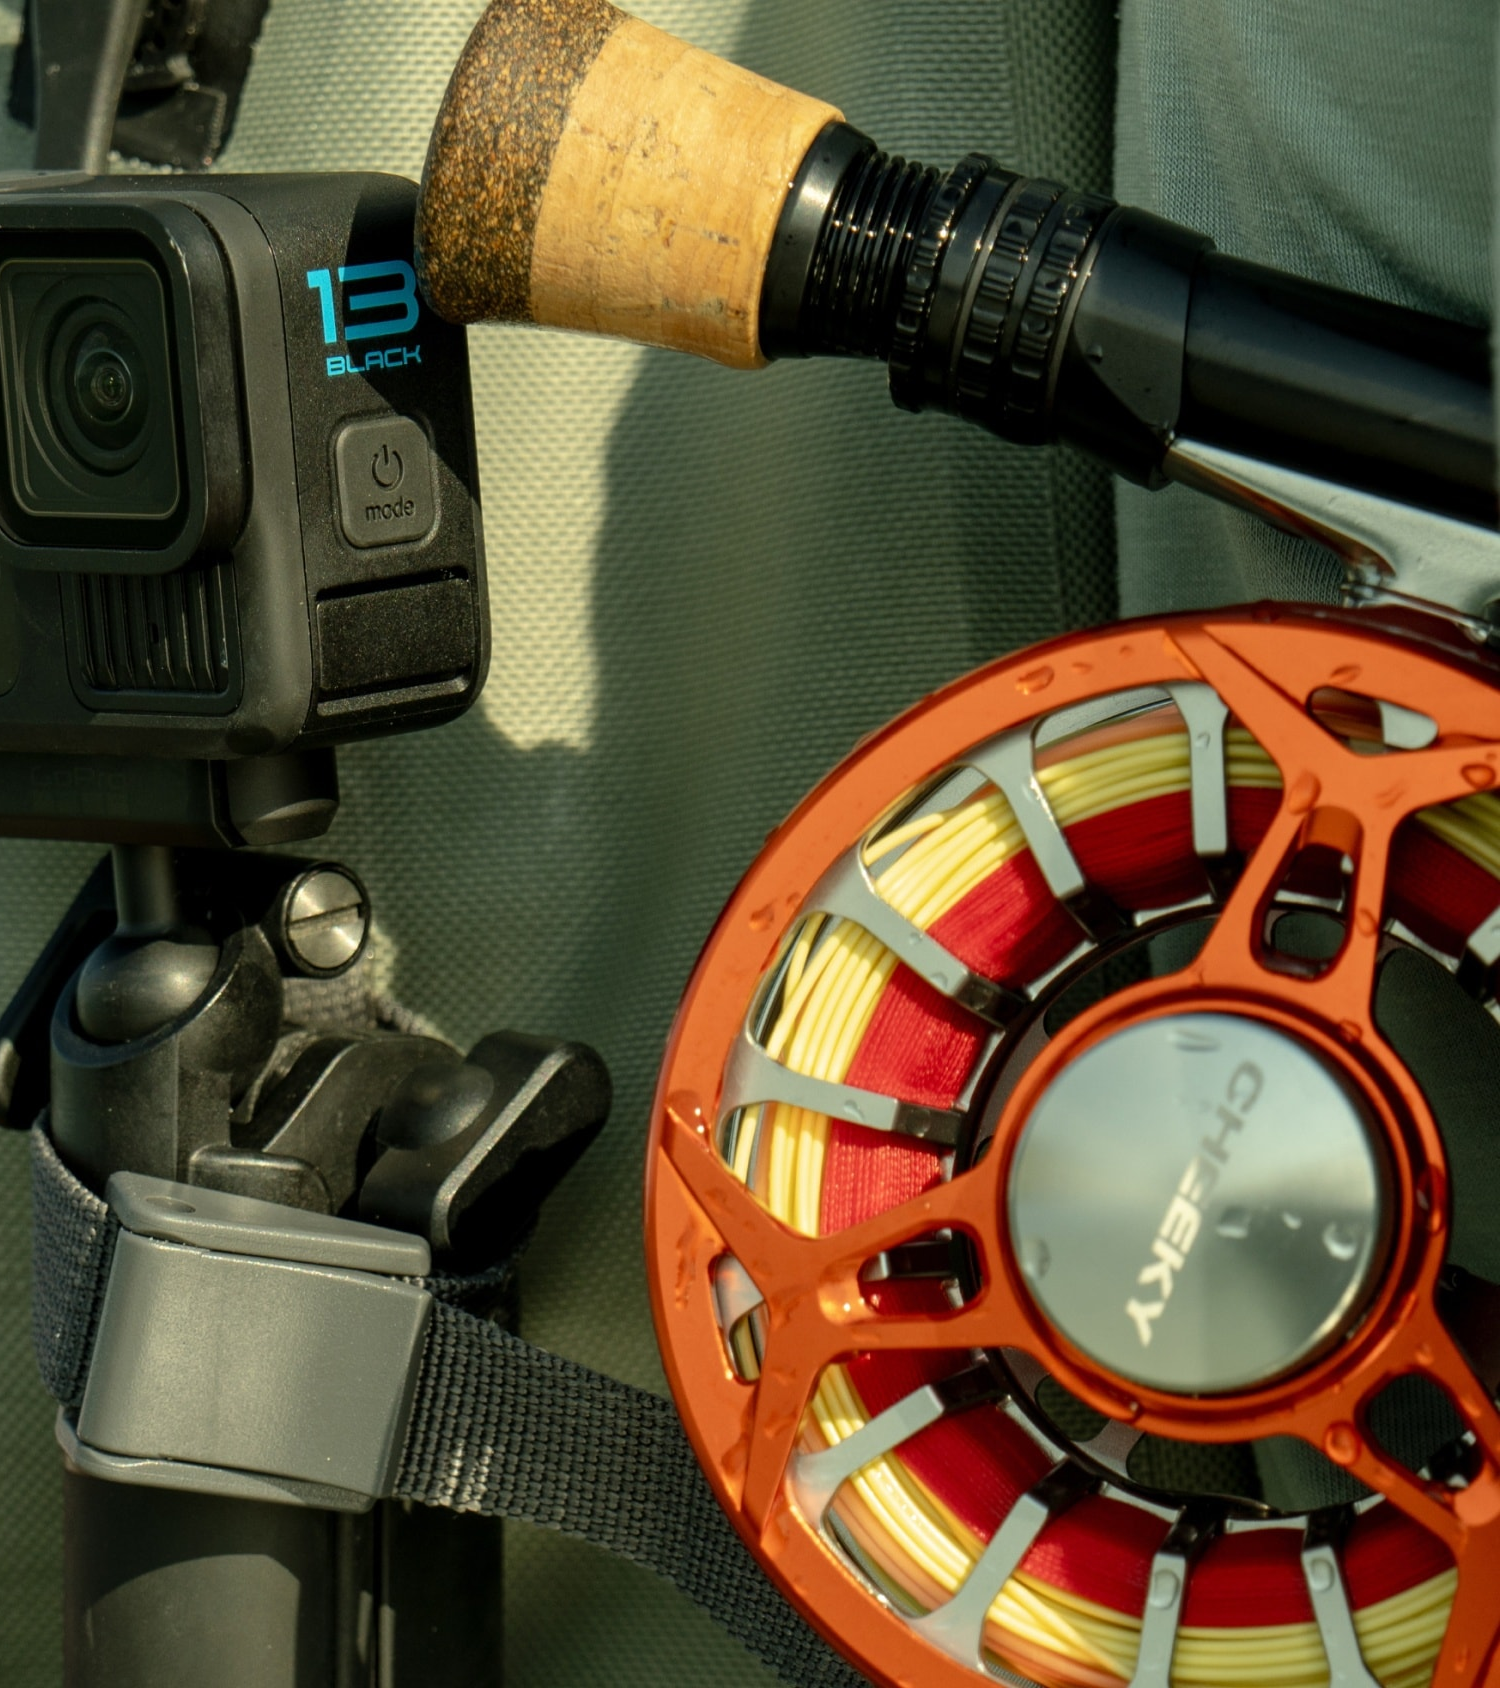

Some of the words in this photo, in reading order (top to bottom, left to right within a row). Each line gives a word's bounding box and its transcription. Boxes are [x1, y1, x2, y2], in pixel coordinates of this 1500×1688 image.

[306, 260, 420, 344] 13
[325, 345, 422, 377] BLACK
[365, 497, 416, 522] mode
[1124, 1060, 1266, 1348] CHEEKY
